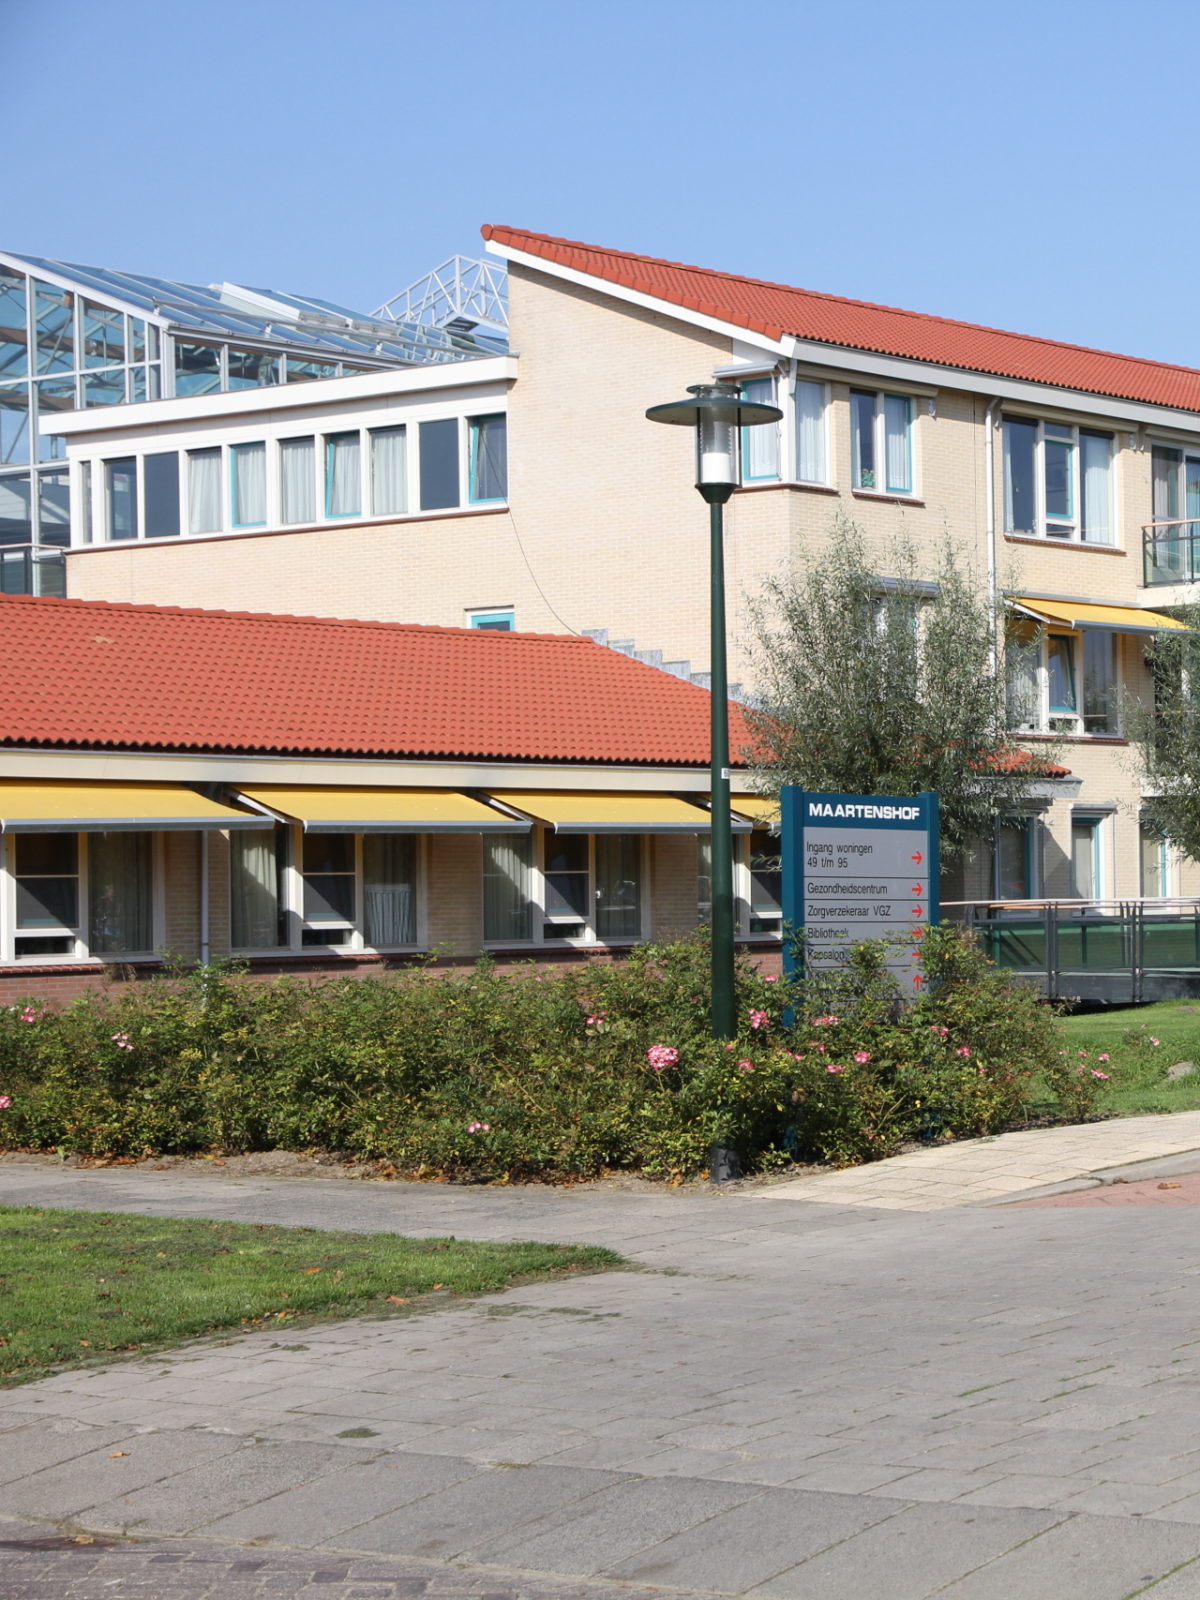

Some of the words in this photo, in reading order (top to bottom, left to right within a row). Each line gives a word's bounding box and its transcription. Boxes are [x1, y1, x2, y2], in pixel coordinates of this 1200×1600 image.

[809, 803, 920, 820] MAARTENSHOF
[806, 842, 833, 855] Ingang
[836, 844, 873, 856] woningen
[807, 858, 818, 868] 49
[821, 857, 834, 868] t/m
[837, 858, 848, 868] 95
[807, 882, 888, 894] Gezondheidscentrum
[807, 905, 869, 919] Zorgverzekeraar
[873, 905, 891, 917] VGZ
